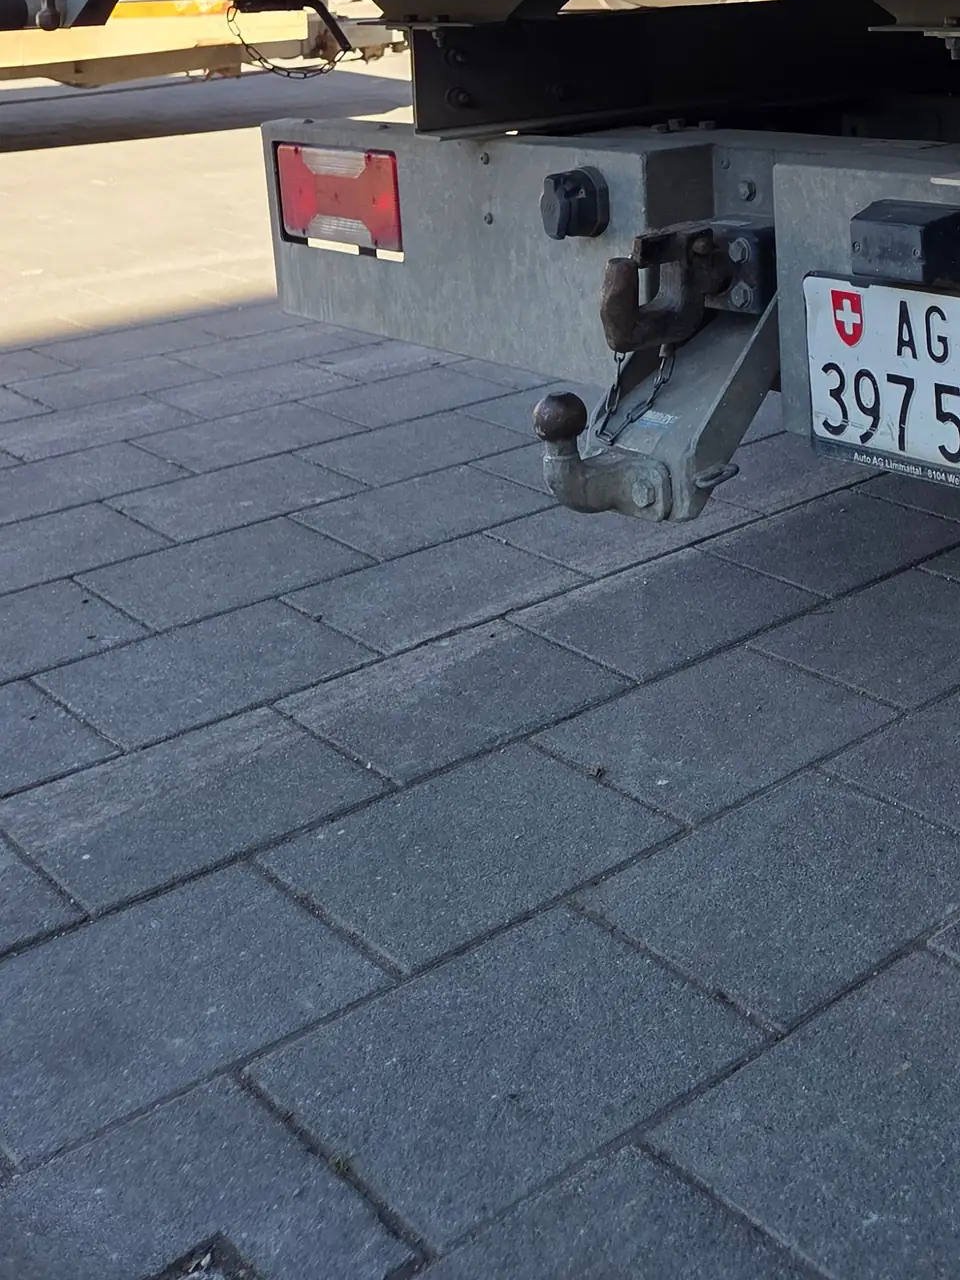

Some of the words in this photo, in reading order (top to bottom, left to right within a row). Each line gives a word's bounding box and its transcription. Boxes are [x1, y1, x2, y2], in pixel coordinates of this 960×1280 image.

[896, 300, 949, 364] AG
[853, 452, 871, 464] Auto
[872, 456, 884, 468] AG
[885, 459, 922, 476] Limmattal
[927, 469, 946, 481] 8104
